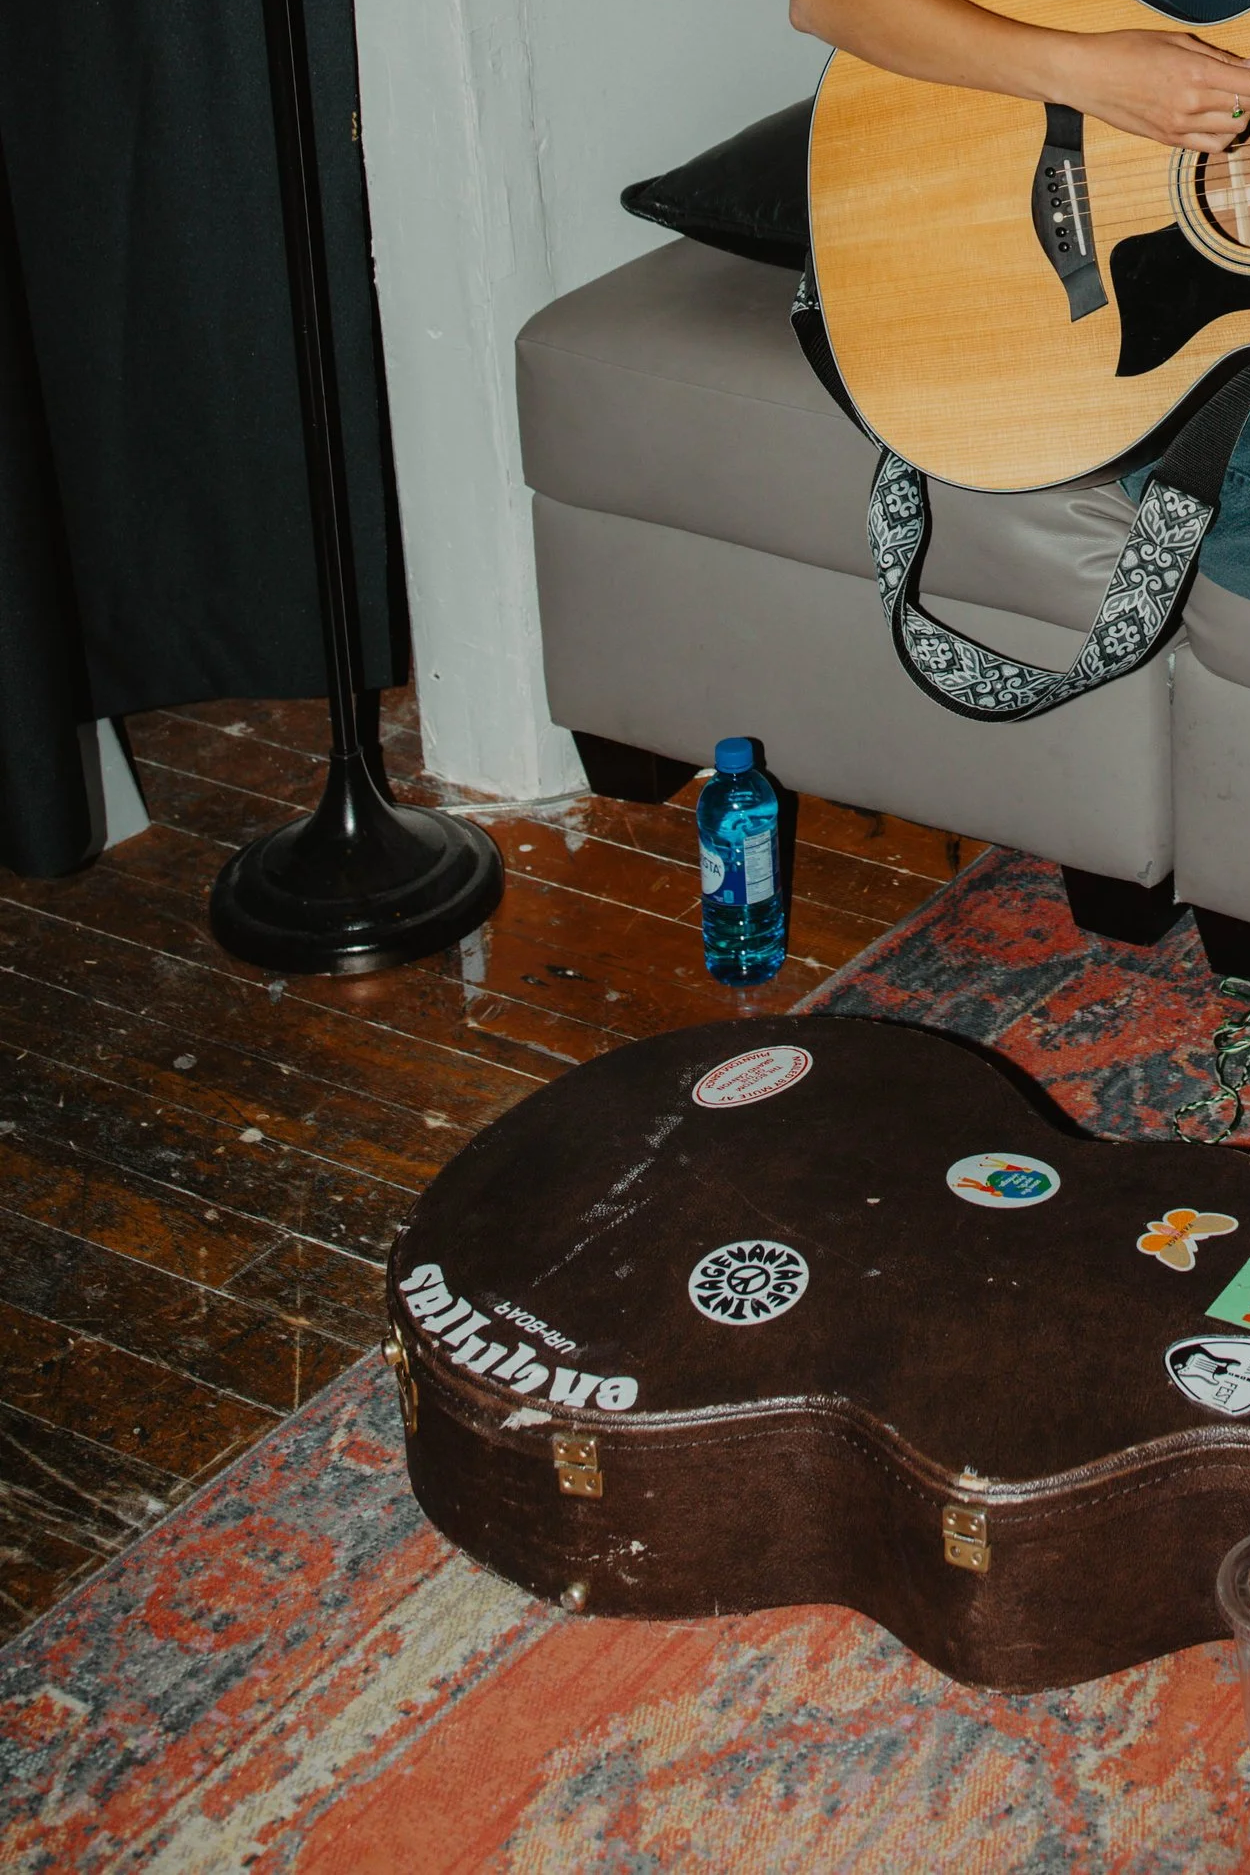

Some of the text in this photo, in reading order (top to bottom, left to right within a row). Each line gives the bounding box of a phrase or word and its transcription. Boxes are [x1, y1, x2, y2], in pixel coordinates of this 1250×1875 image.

[694, 1243, 803, 1320] VANTAGE VINTAGE
[1212, 1380, 1238, 1405] FEST
